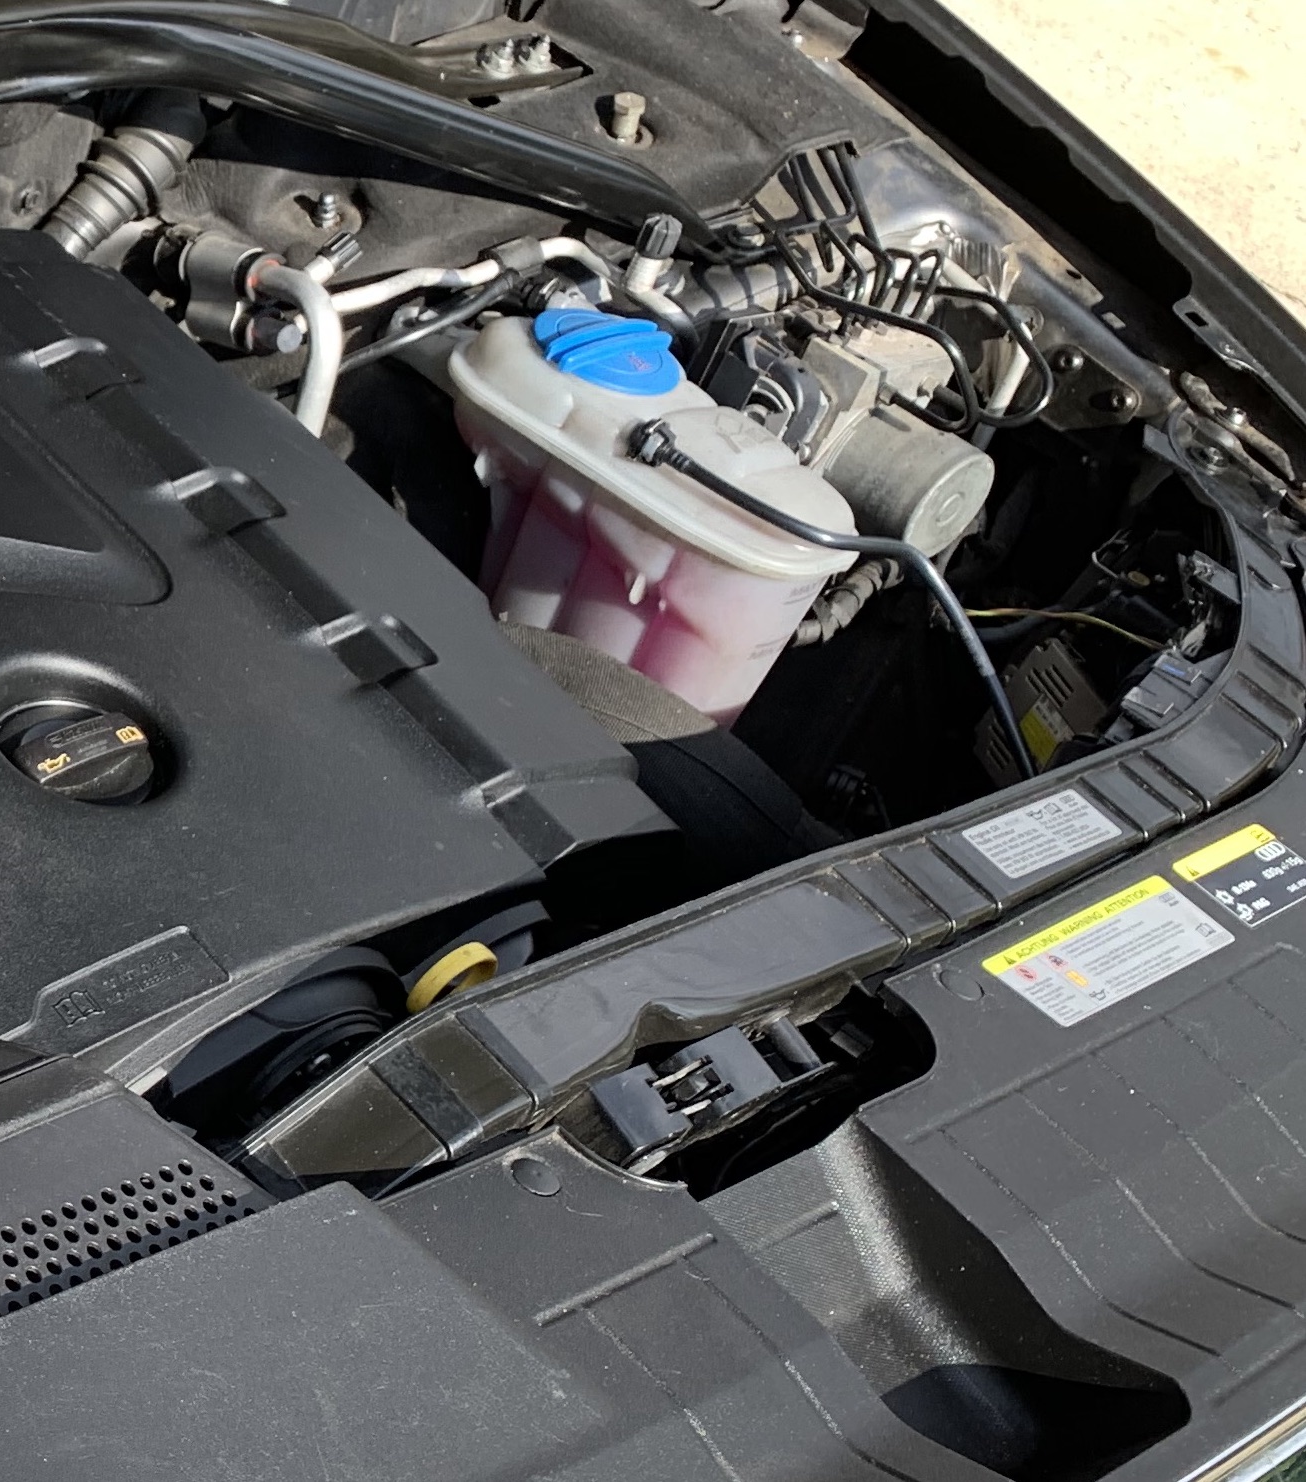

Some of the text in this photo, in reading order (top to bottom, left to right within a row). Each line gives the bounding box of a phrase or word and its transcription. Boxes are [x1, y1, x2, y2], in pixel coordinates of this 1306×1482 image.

[1016, 888, 1150, 959] ACHTUNG WARNING ATTENTION
